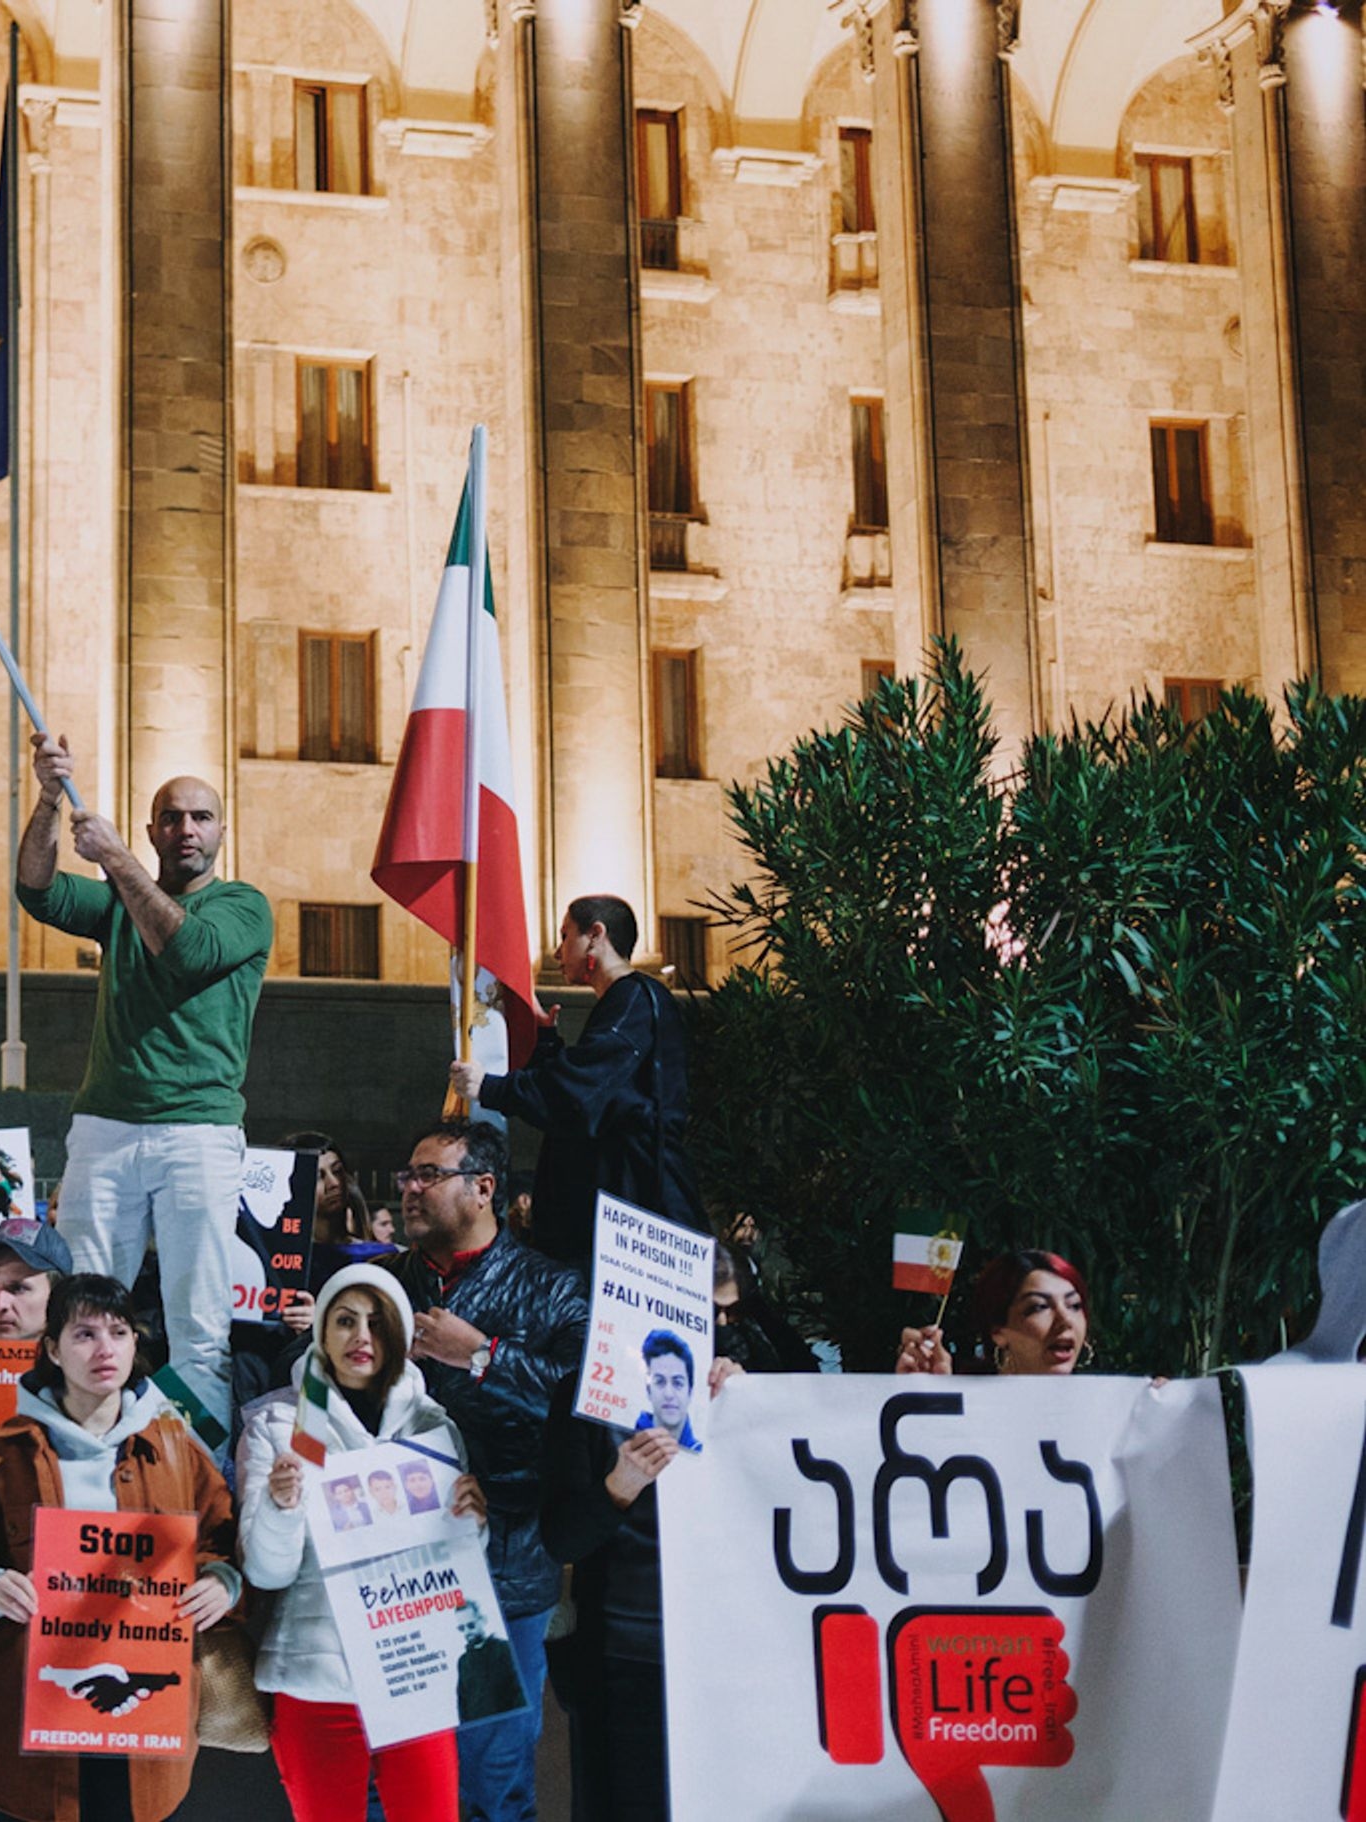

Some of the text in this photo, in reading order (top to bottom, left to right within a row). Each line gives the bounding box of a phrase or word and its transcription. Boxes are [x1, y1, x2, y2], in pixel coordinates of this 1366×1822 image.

[282, 1218, 301, 1234] BE
[603, 1205, 708, 1260] HAPPY BIRTHDAY
[271, 1254, 303, 1270] OUR
[615, 1232, 628, 1250] IN
[632, 1238, 675, 1270] PRISON
[622, 1262, 644, 1277] GOLD
[646, 1272, 673, 1289] MEDAL
[676, 1285, 707, 1303] WINNER
[602, 1280, 707, 1335] #ALI YOUNESI
[598, 1319, 614, 1335] HE
[597, 1341, 609, 1355] IS
[590, 1362, 615, 1386] 22
[587, 1385, 627, 1409] YEARS
[584, 1402, 611, 1419] OLD
[773, 1392, 1104, 1597] არა
[80, 1524, 154, 1563] Stop
[47, 1572, 187, 1598] shaking their
[358, 1568, 459, 1609] Behnam
[367, 1589, 467, 1630] LAYEGHPOUR
[41, 1616, 189, 1643] bloody hands.
[392, 1634, 407, 1646] year
[927, 1634, 1033, 1655] woman
[908, 1633, 923, 1740] #MahsaAmini
[930, 1657, 1033, 1714] Life
[30, 1730, 182, 1749] FREEDOM FOR IRAN
[928, 1717, 1037, 1742] Freedom
